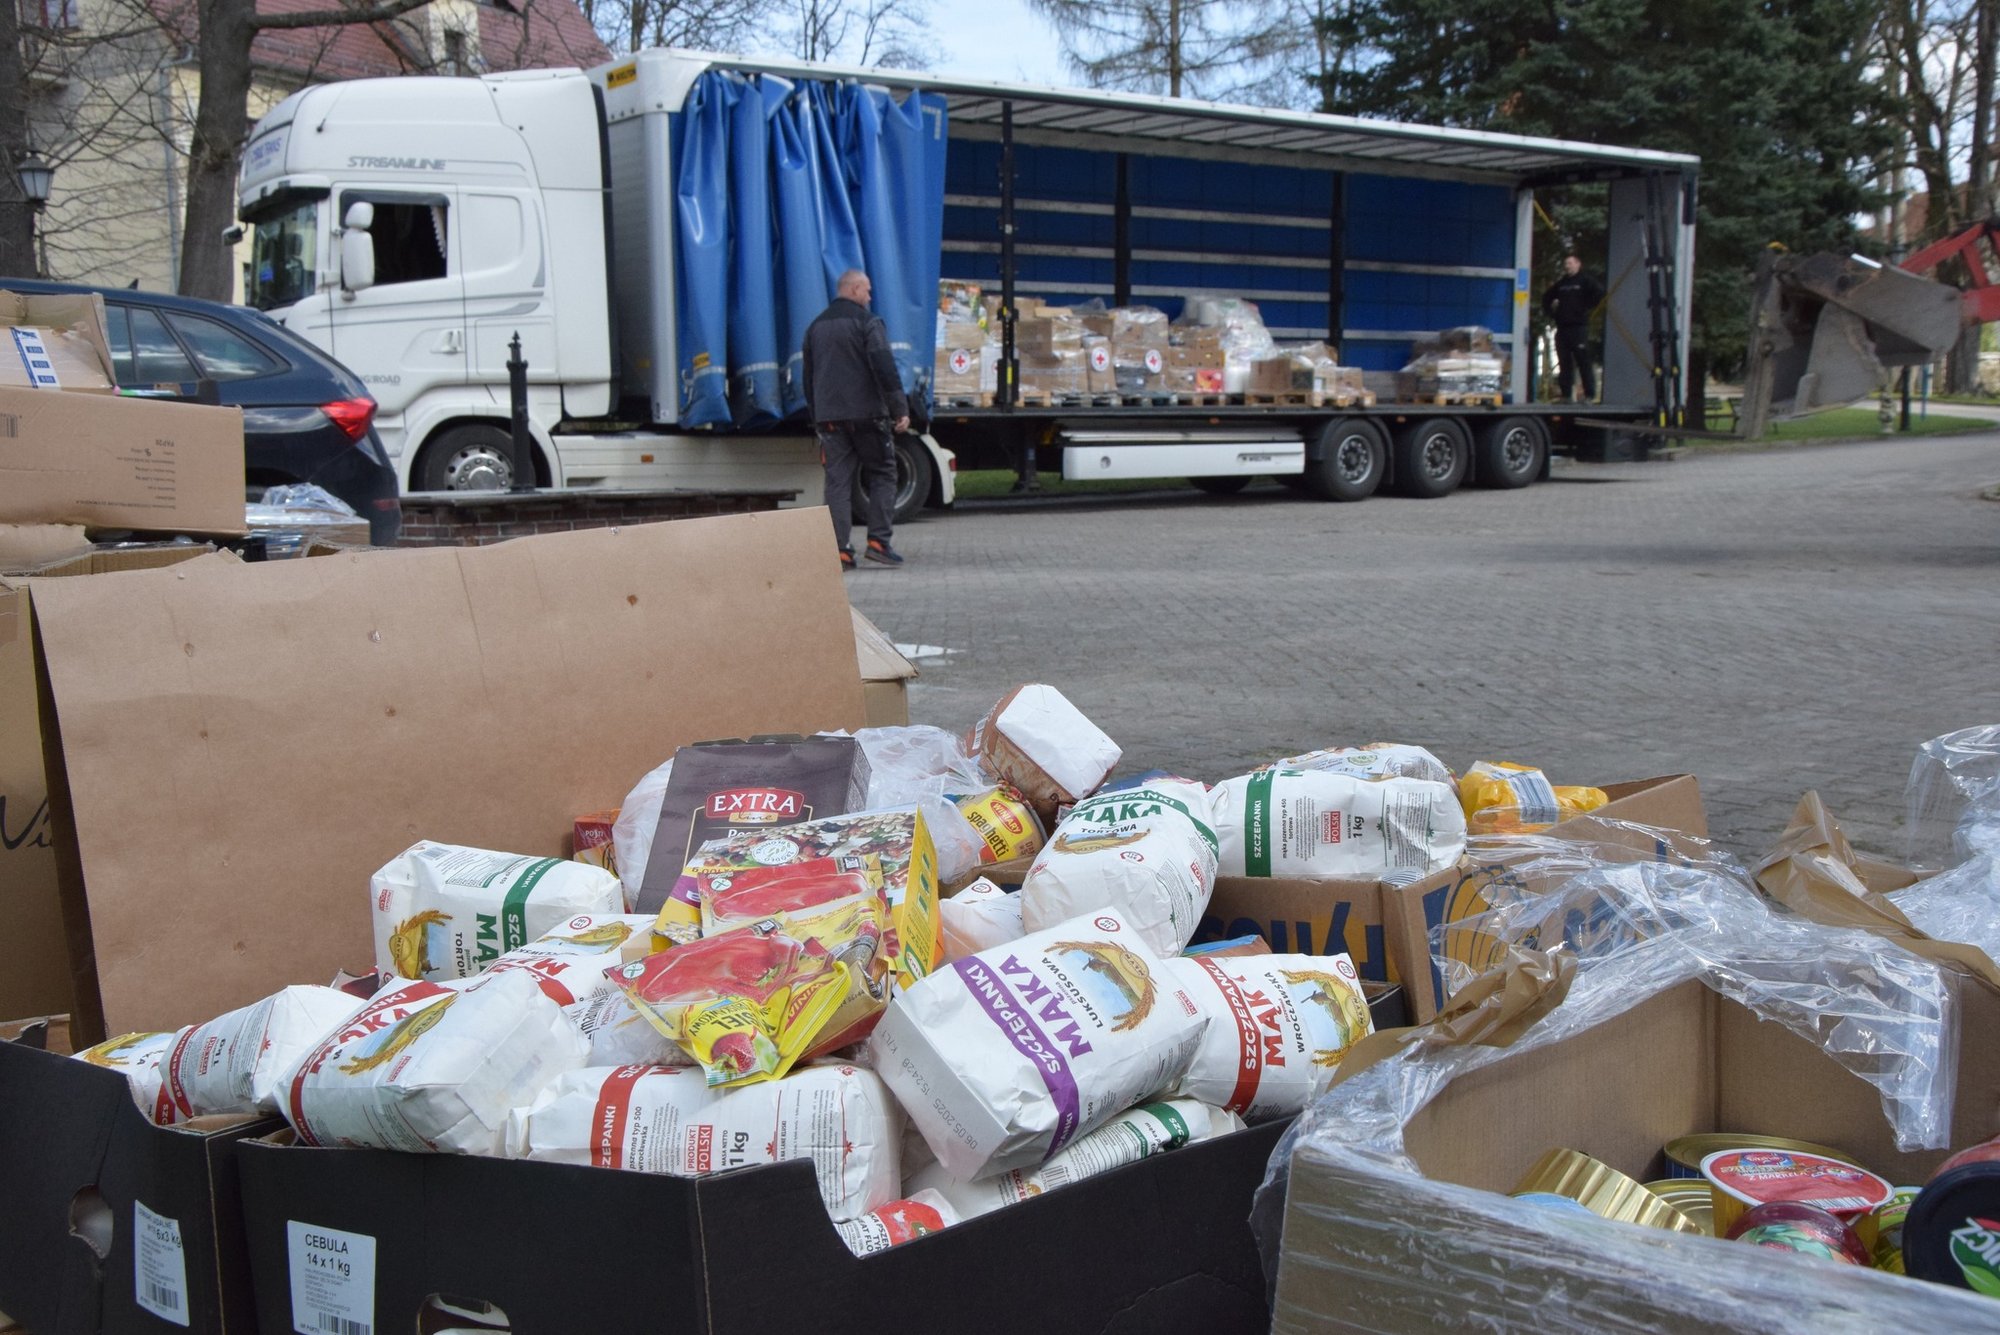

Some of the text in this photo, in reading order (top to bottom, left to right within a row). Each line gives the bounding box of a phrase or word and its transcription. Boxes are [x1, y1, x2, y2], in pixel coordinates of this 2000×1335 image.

[347, 155, 447, 170] STREAMLINE
[713, 793, 795, 813] EXTRA
[993, 802, 1020, 832] WINIARY
[967, 811, 1009, 858] spaghetti
[1081, 823, 1137, 834] TORTOWA
[1254, 799, 1263, 859] SZCZEPANKI
[1331, 811, 1340, 843] POLSKI
[1353, 815, 1365, 832] kg
[454, 932, 468, 980] TORTOW
[476, 912, 500, 972] MĄ
[787, 983, 825, 1018] WINIA
[999, 954, 1094, 1060] MĄKA
[1041, 957, 1104, 1029] LUKSUSOWA
[1178, 989, 1198, 1015] POLSKI
[710, 1011, 778, 1035] KSIEL
[966, 964, 1062, 1075] SZCZEPANKI
[1209, 964, 1256, 1070] SZCZEPANKI
[1264, 971, 1305, 1053] WROCŁAWSKA
[602, 1105, 617, 1168] ZEPANKI
[632, 1120, 641, 1136] typ
[933, 1098, 978, 1150] 06.05.2025
[629, 1136, 638, 1170] pszenna
[638, 1125, 649, 1171] wrocławska
[688, 1129, 697, 1169] PRODUKT
[700, 1126, 711, 1171] POLSKI
[730, 1131, 749, 1166] 1 kg
[305, 1233, 348, 1254] CEBULA
[306, 1252, 351, 1277] 14 x 1 kg
